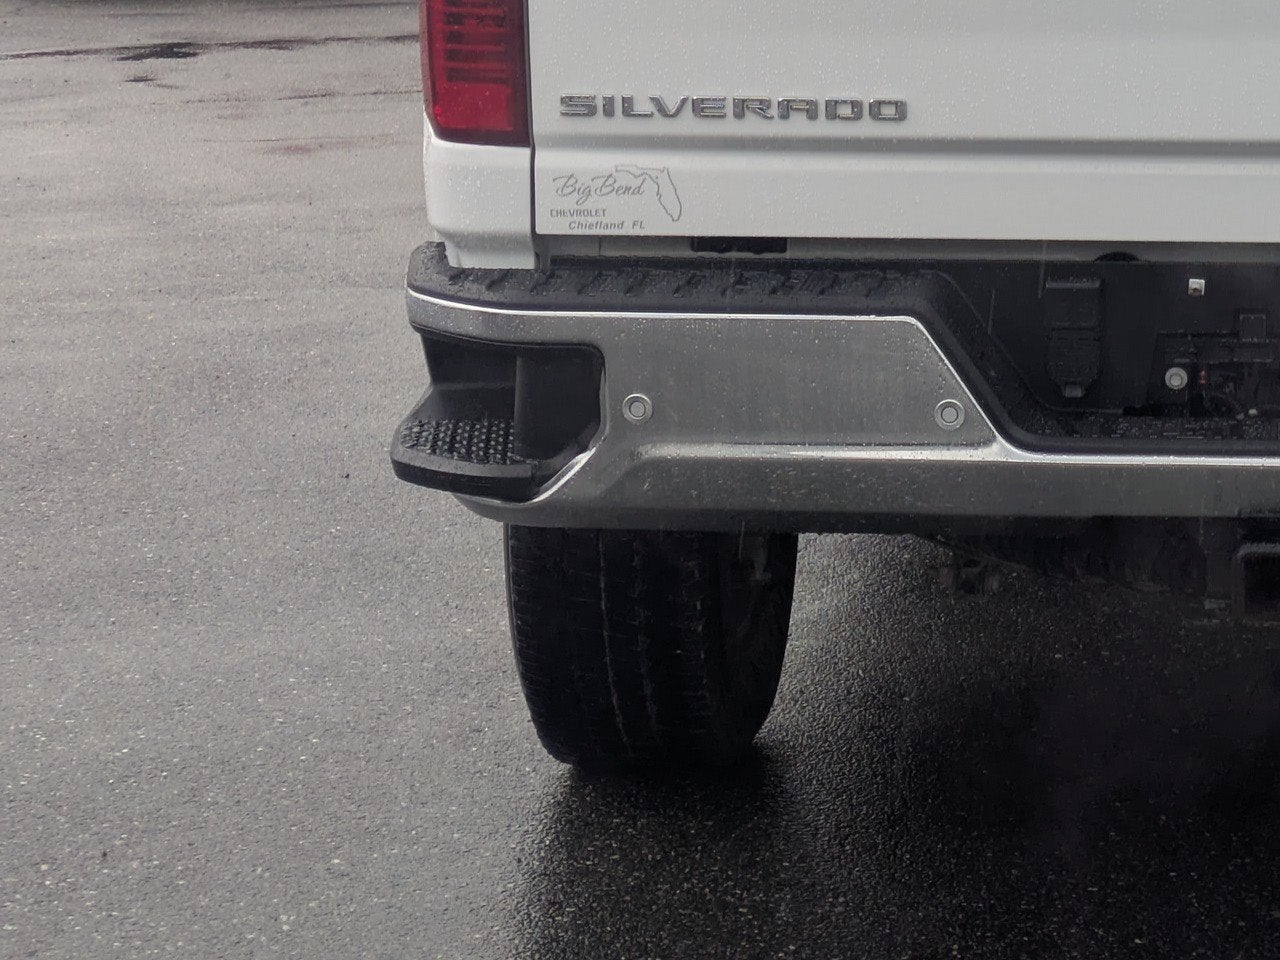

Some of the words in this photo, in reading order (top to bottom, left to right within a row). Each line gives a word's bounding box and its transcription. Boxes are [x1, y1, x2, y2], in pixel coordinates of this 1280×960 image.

[559, 93, 908, 122] SILVERADO
[553, 173, 592, 205] Big
[591, 173, 646, 197] Bend
[550, 208, 607, 218] CHEVROLET
[632, 220, 645, 230] FL
